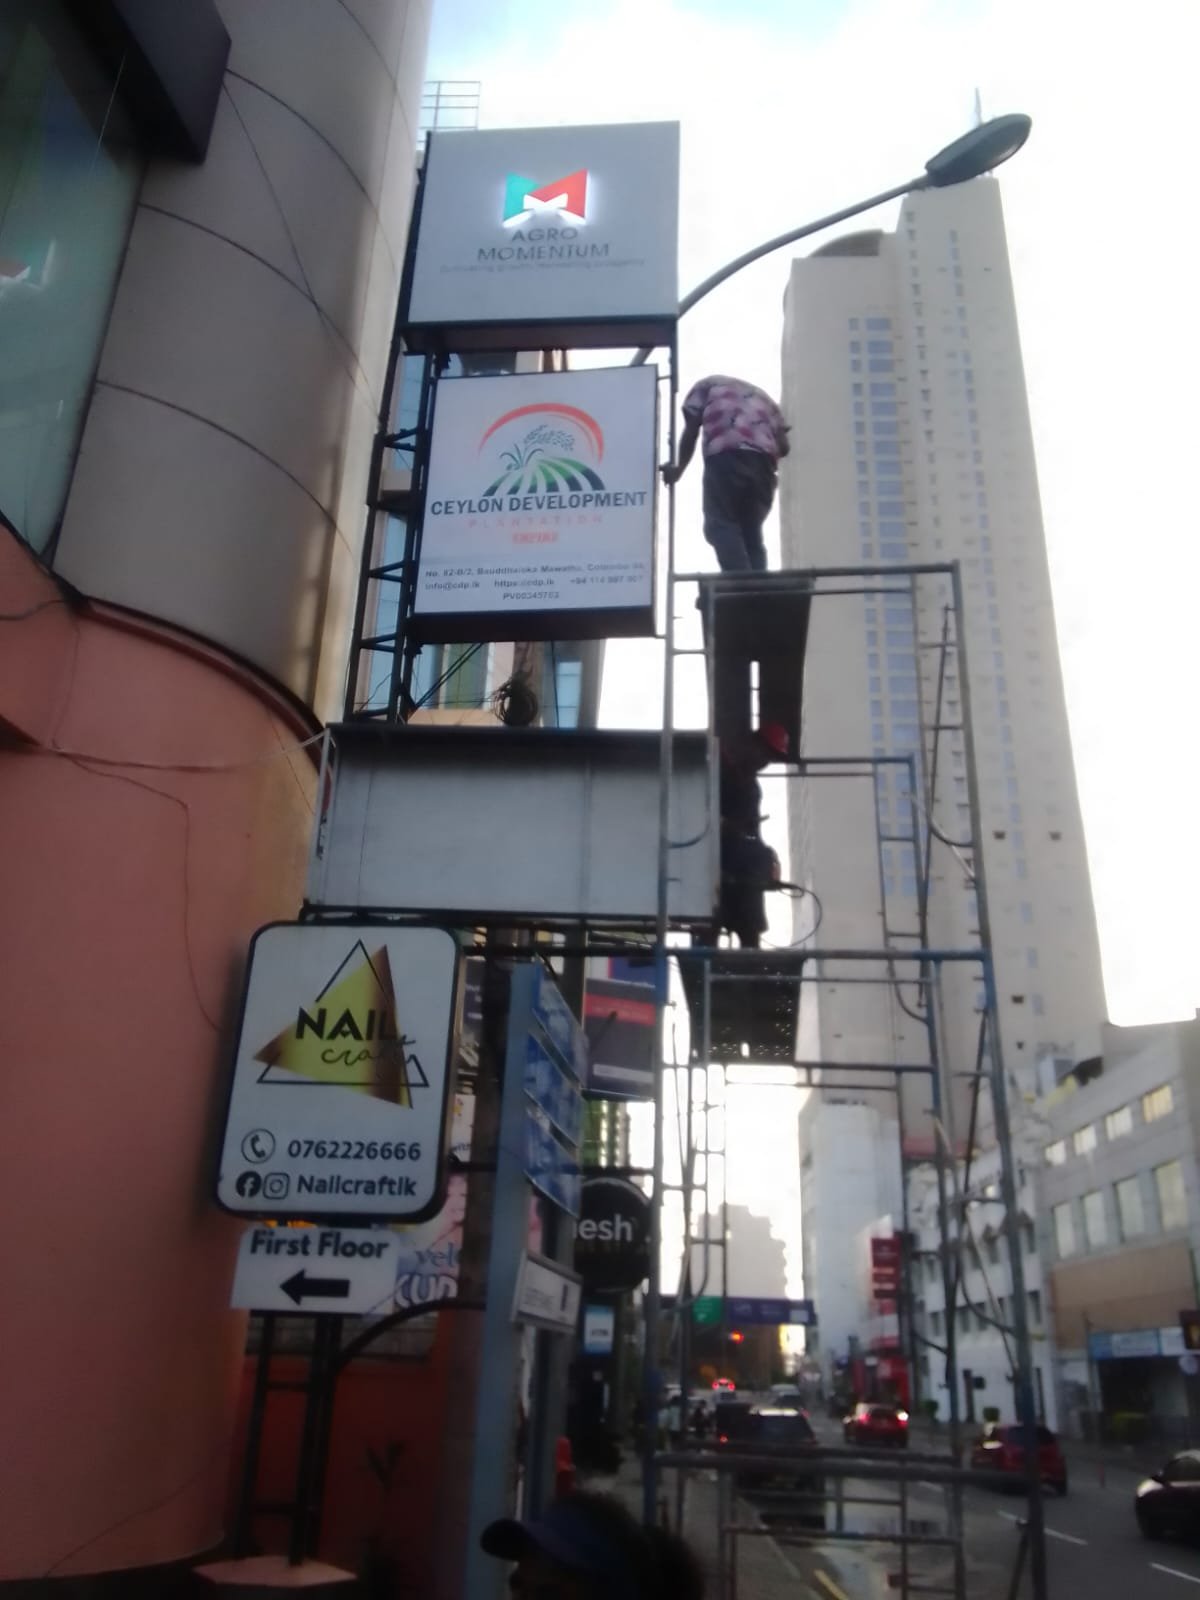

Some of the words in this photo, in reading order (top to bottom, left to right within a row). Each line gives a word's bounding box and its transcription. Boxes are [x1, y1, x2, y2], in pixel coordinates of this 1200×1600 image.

[511, 227, 579, 243] AGRO
[476, 243, 610, 262] MOMENTUM
[430, 497, 504, 515] CEYLON
[508, 491, 648, 512] DEVELOPMENT
[295, 1007, 398, 1041] NAIL
[287, 1139, 422, 1161] 0762226666
[250, 1229, 312, 1256] First
[317, 1230, 390, 1259] Floor
